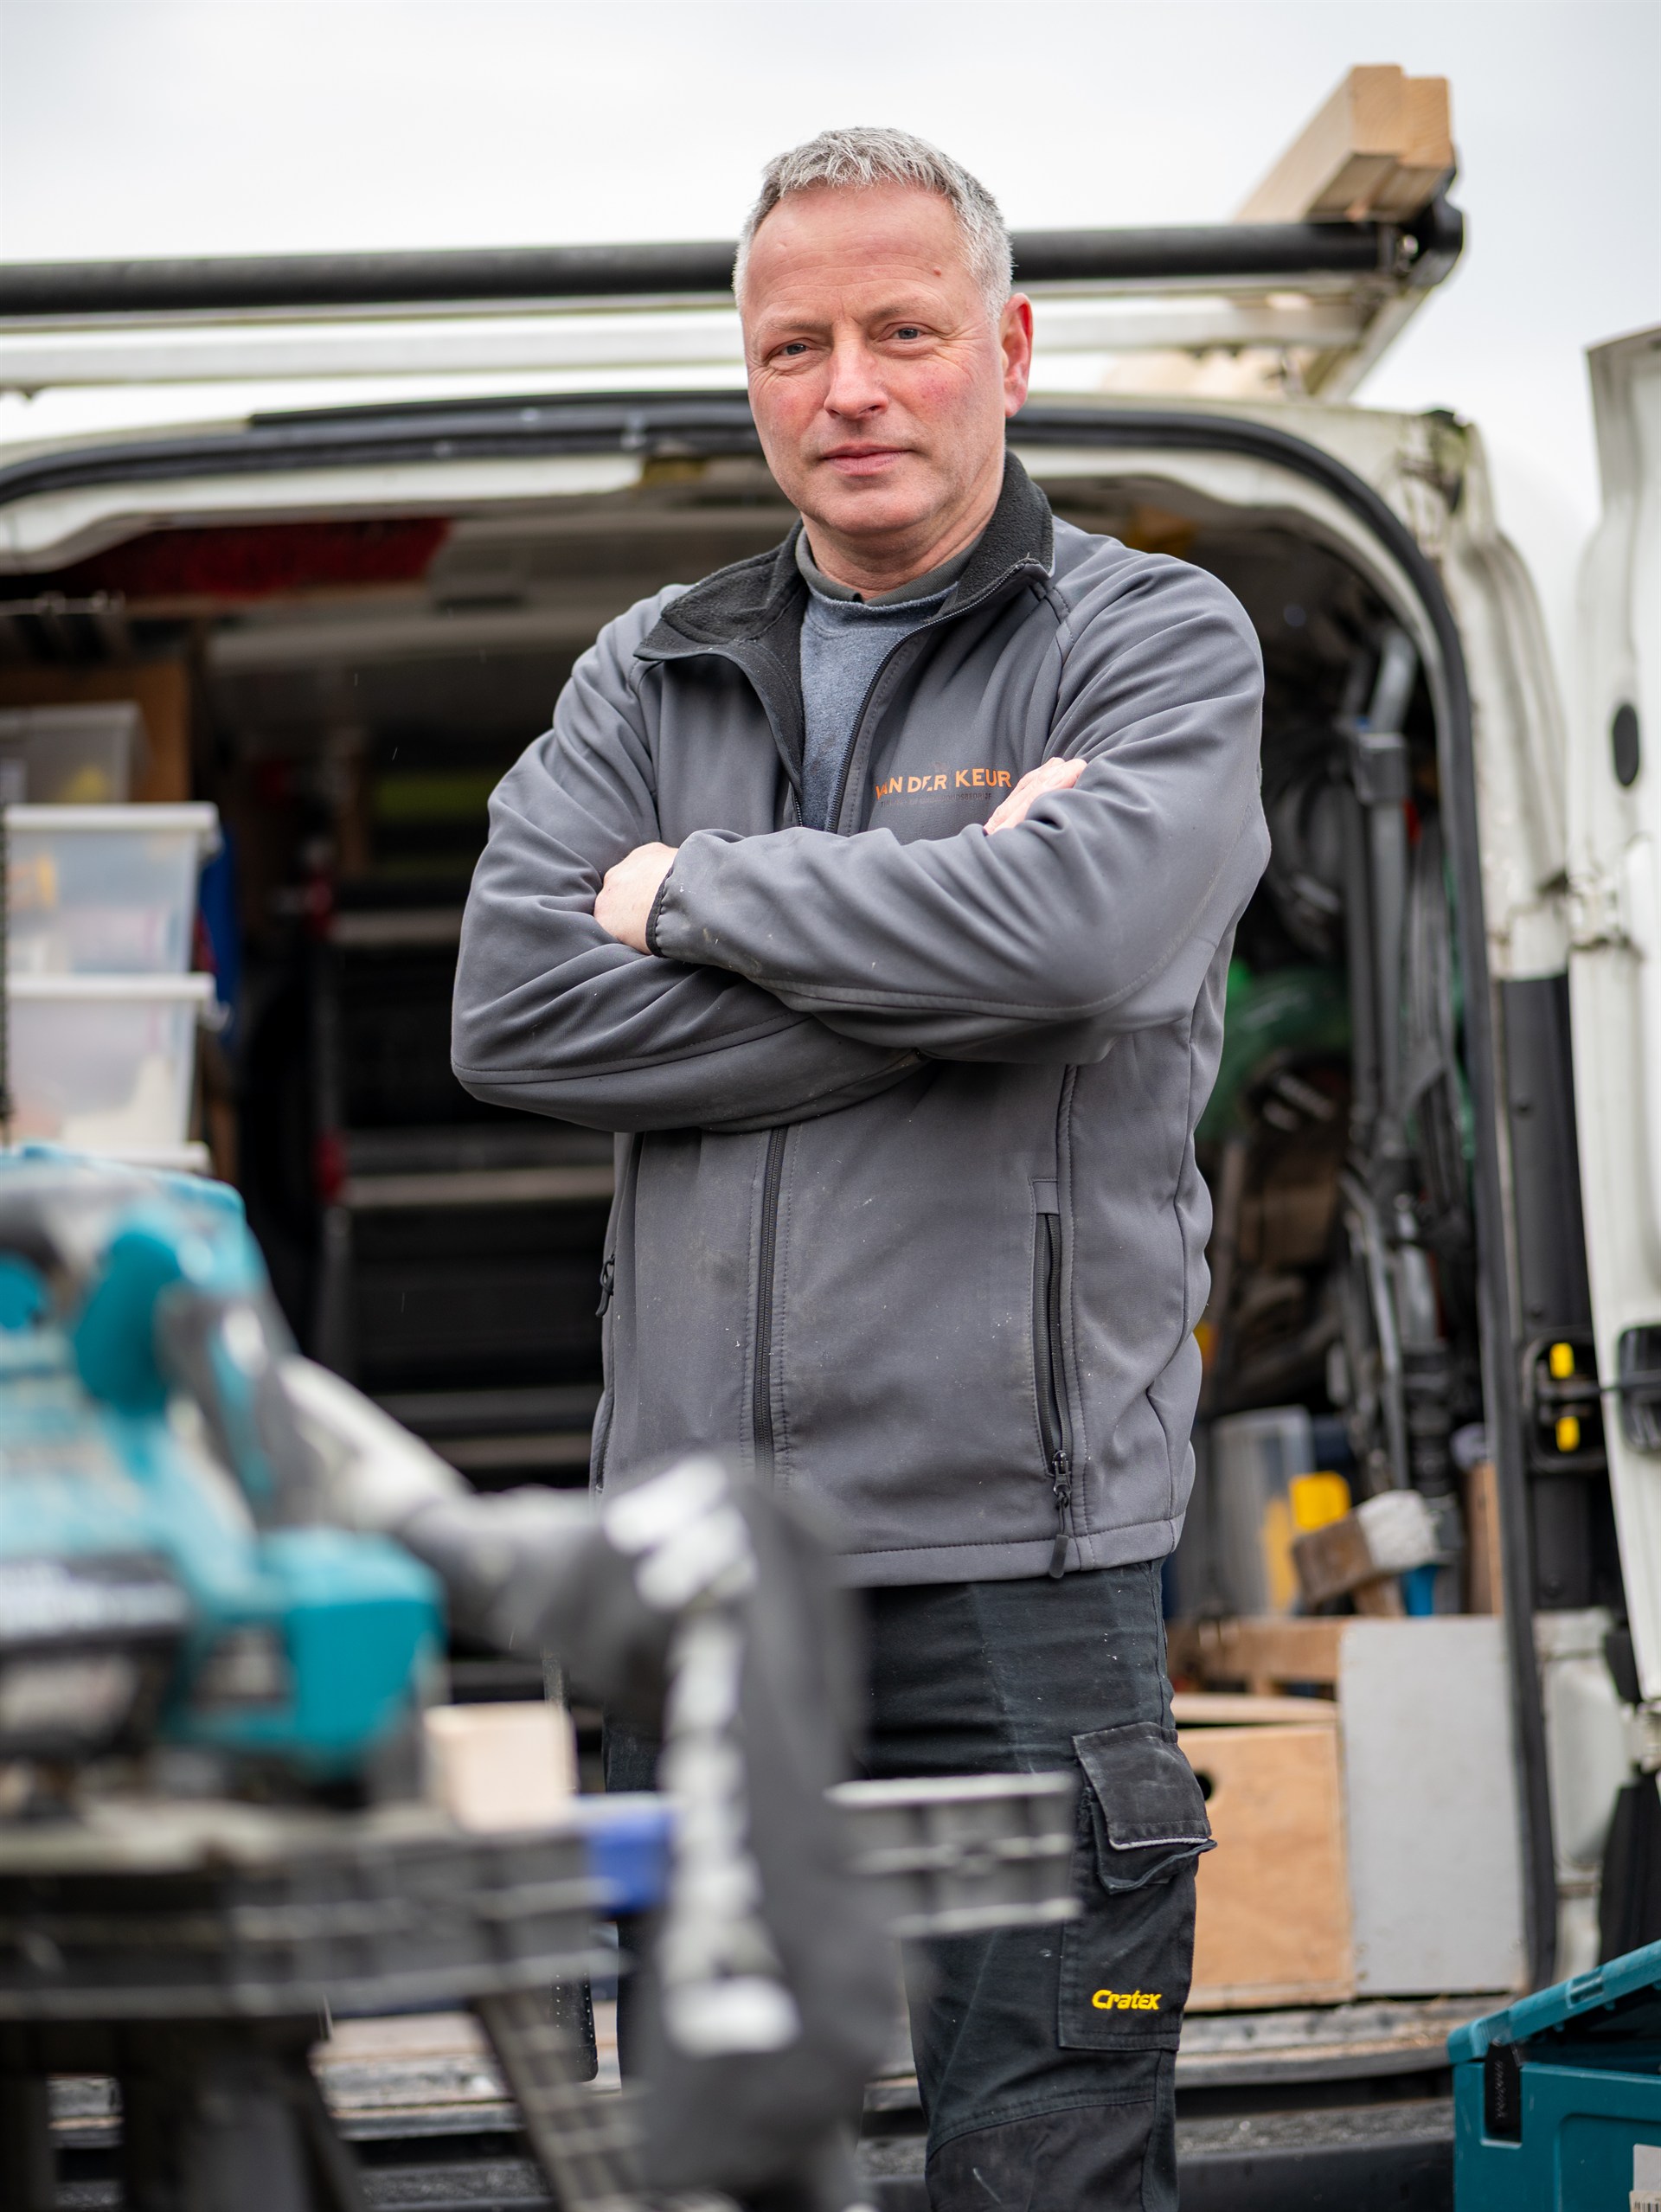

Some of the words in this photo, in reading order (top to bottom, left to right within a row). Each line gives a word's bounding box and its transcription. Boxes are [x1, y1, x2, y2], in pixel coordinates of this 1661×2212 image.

[907, 774, 948, 793] DER
[955, 768, 1012, 788] KEUR
[1092, 1989, 1162, 2010] Cratex
